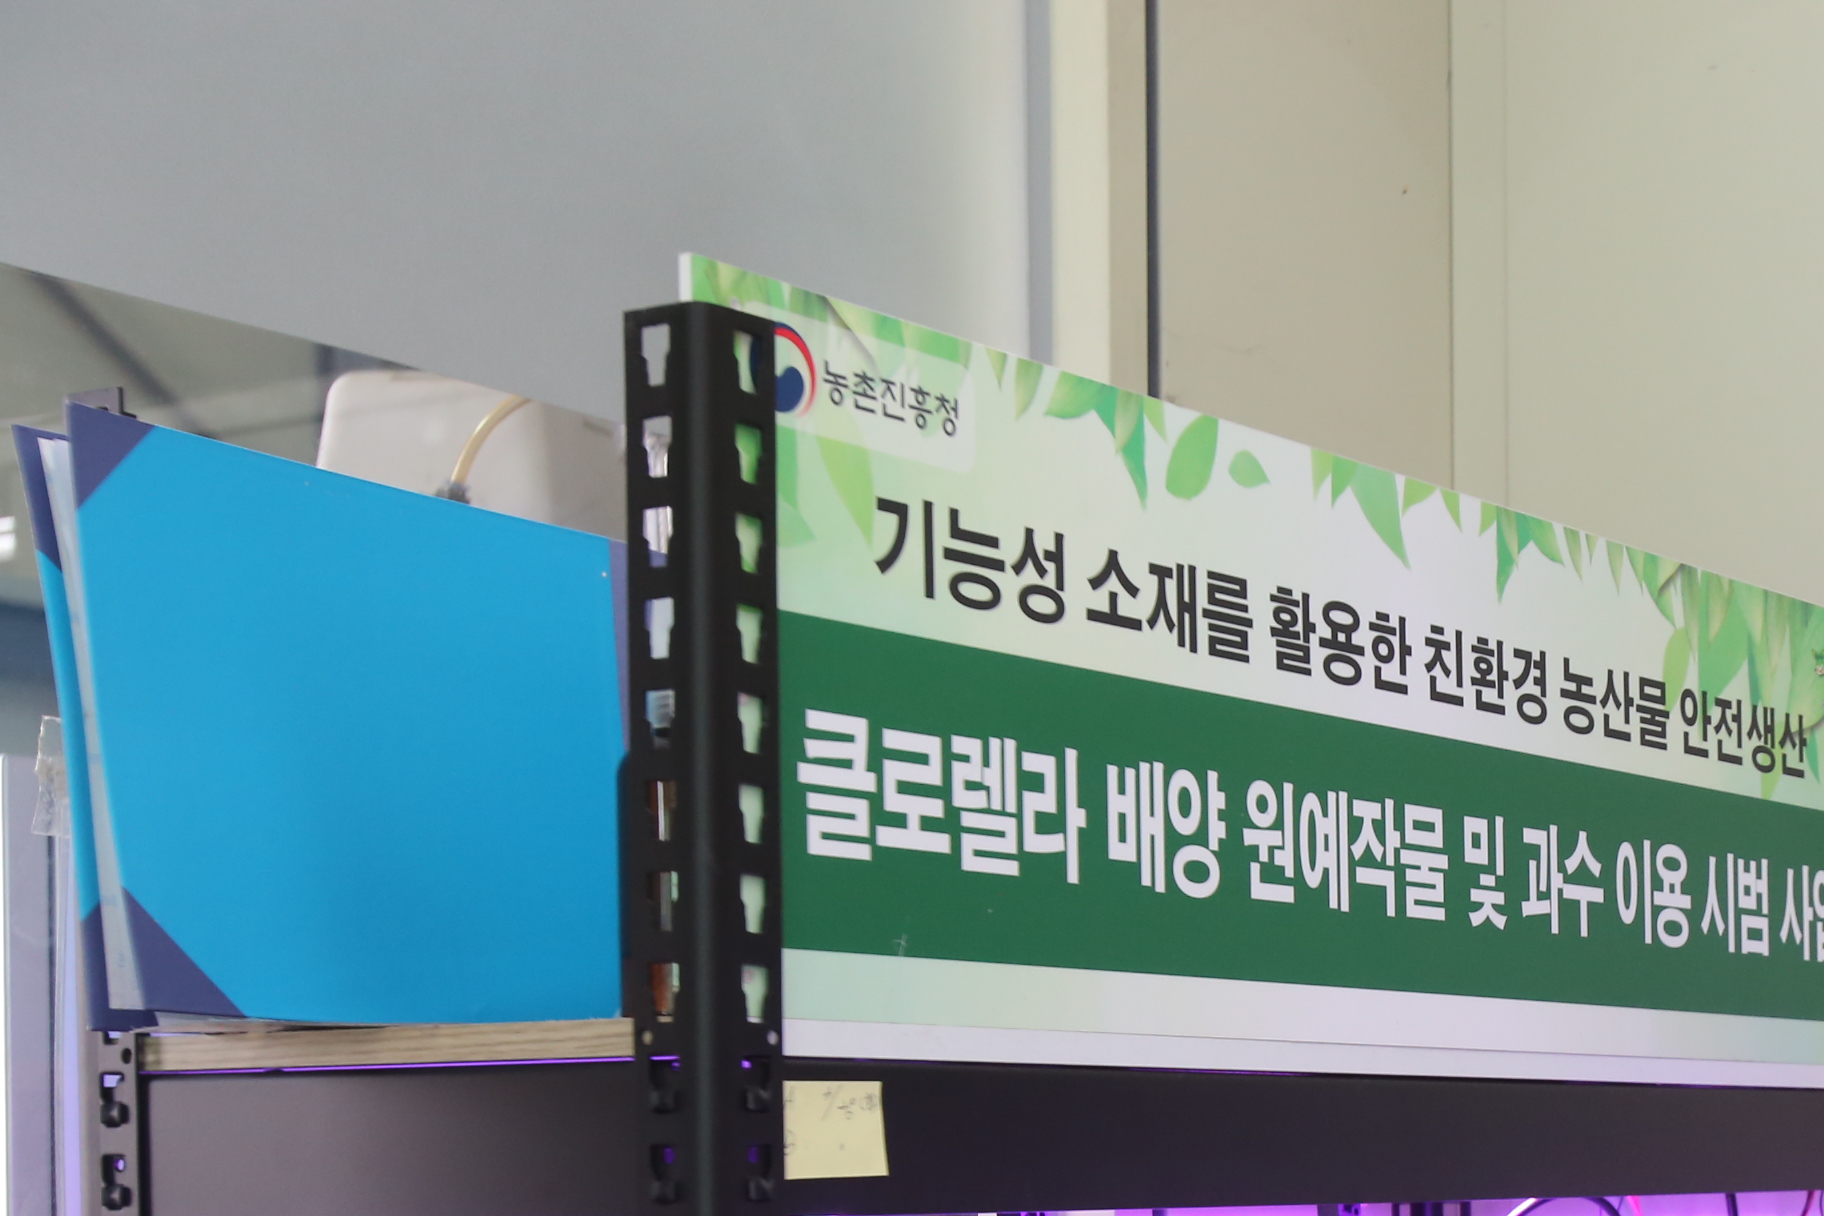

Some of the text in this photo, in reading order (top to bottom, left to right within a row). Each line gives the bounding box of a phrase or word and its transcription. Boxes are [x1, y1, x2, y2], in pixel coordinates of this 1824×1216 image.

[820, 358, 962, 439] 농촌진흥청
[876, 494, 1808, 781] 기능성 소재를 활용한 친환경 농산물 안전생산
[797, 709, 1088, 885] 클로렐라
[1106, 759, 1228, 897] 배양
[1240, 778, 1450, 922] 원예작물
[1460, 811, 1509, 929] 및
[1519, 825, 1603, 939] 과수
[1614, 840, 1693, 951] 이용
[1700, 850, 1771, 959] 시범
